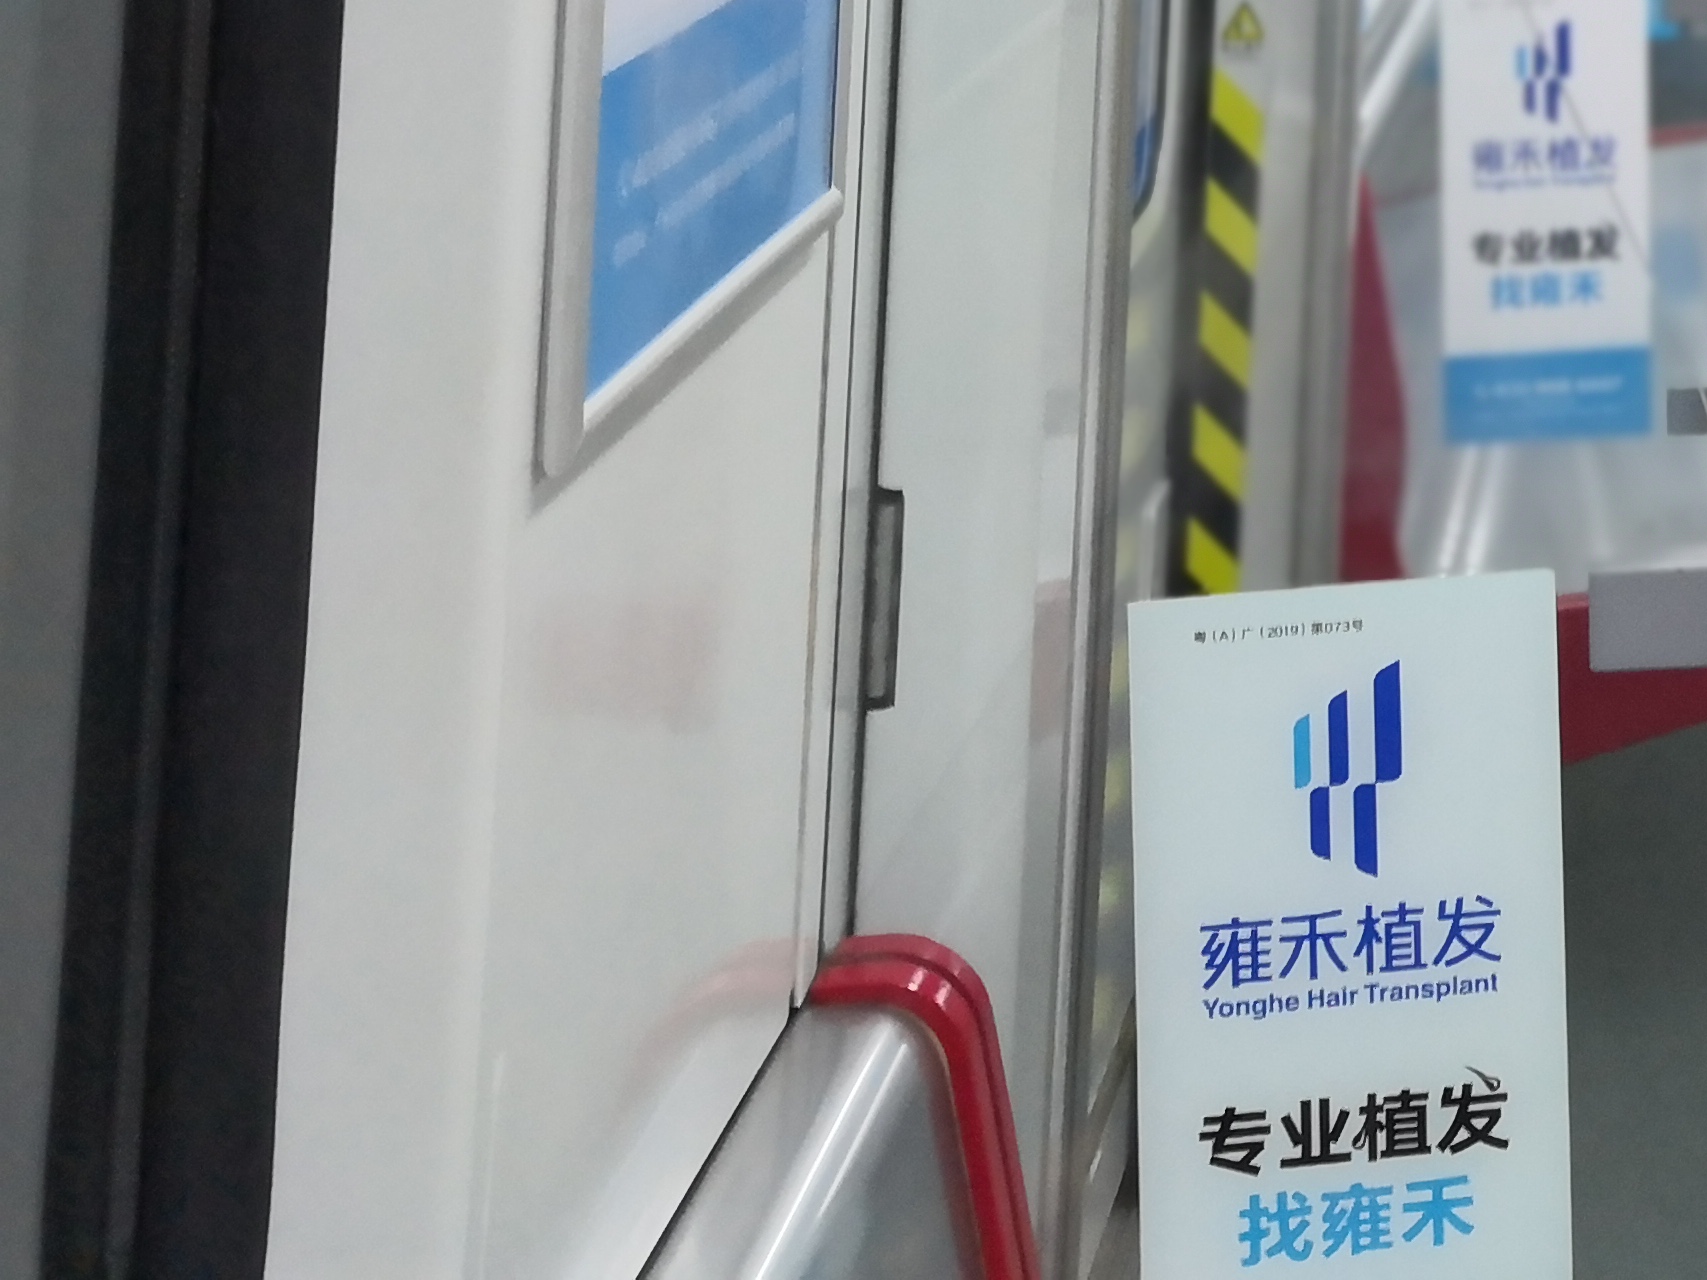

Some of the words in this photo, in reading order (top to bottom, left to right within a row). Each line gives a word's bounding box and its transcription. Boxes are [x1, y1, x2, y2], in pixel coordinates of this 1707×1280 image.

[1200, 894, 1502, 991] 雍禾植发
[1203, 993, 1300, 1020] Yonghe
[1307, 987, 1358, 1010] Hair
[1364, 972, 1498, 1004] Transplant
[1198, 1065, 1511, 1177] 专业植发
[1238, 1175, 1475, 1268] 找雍禾
